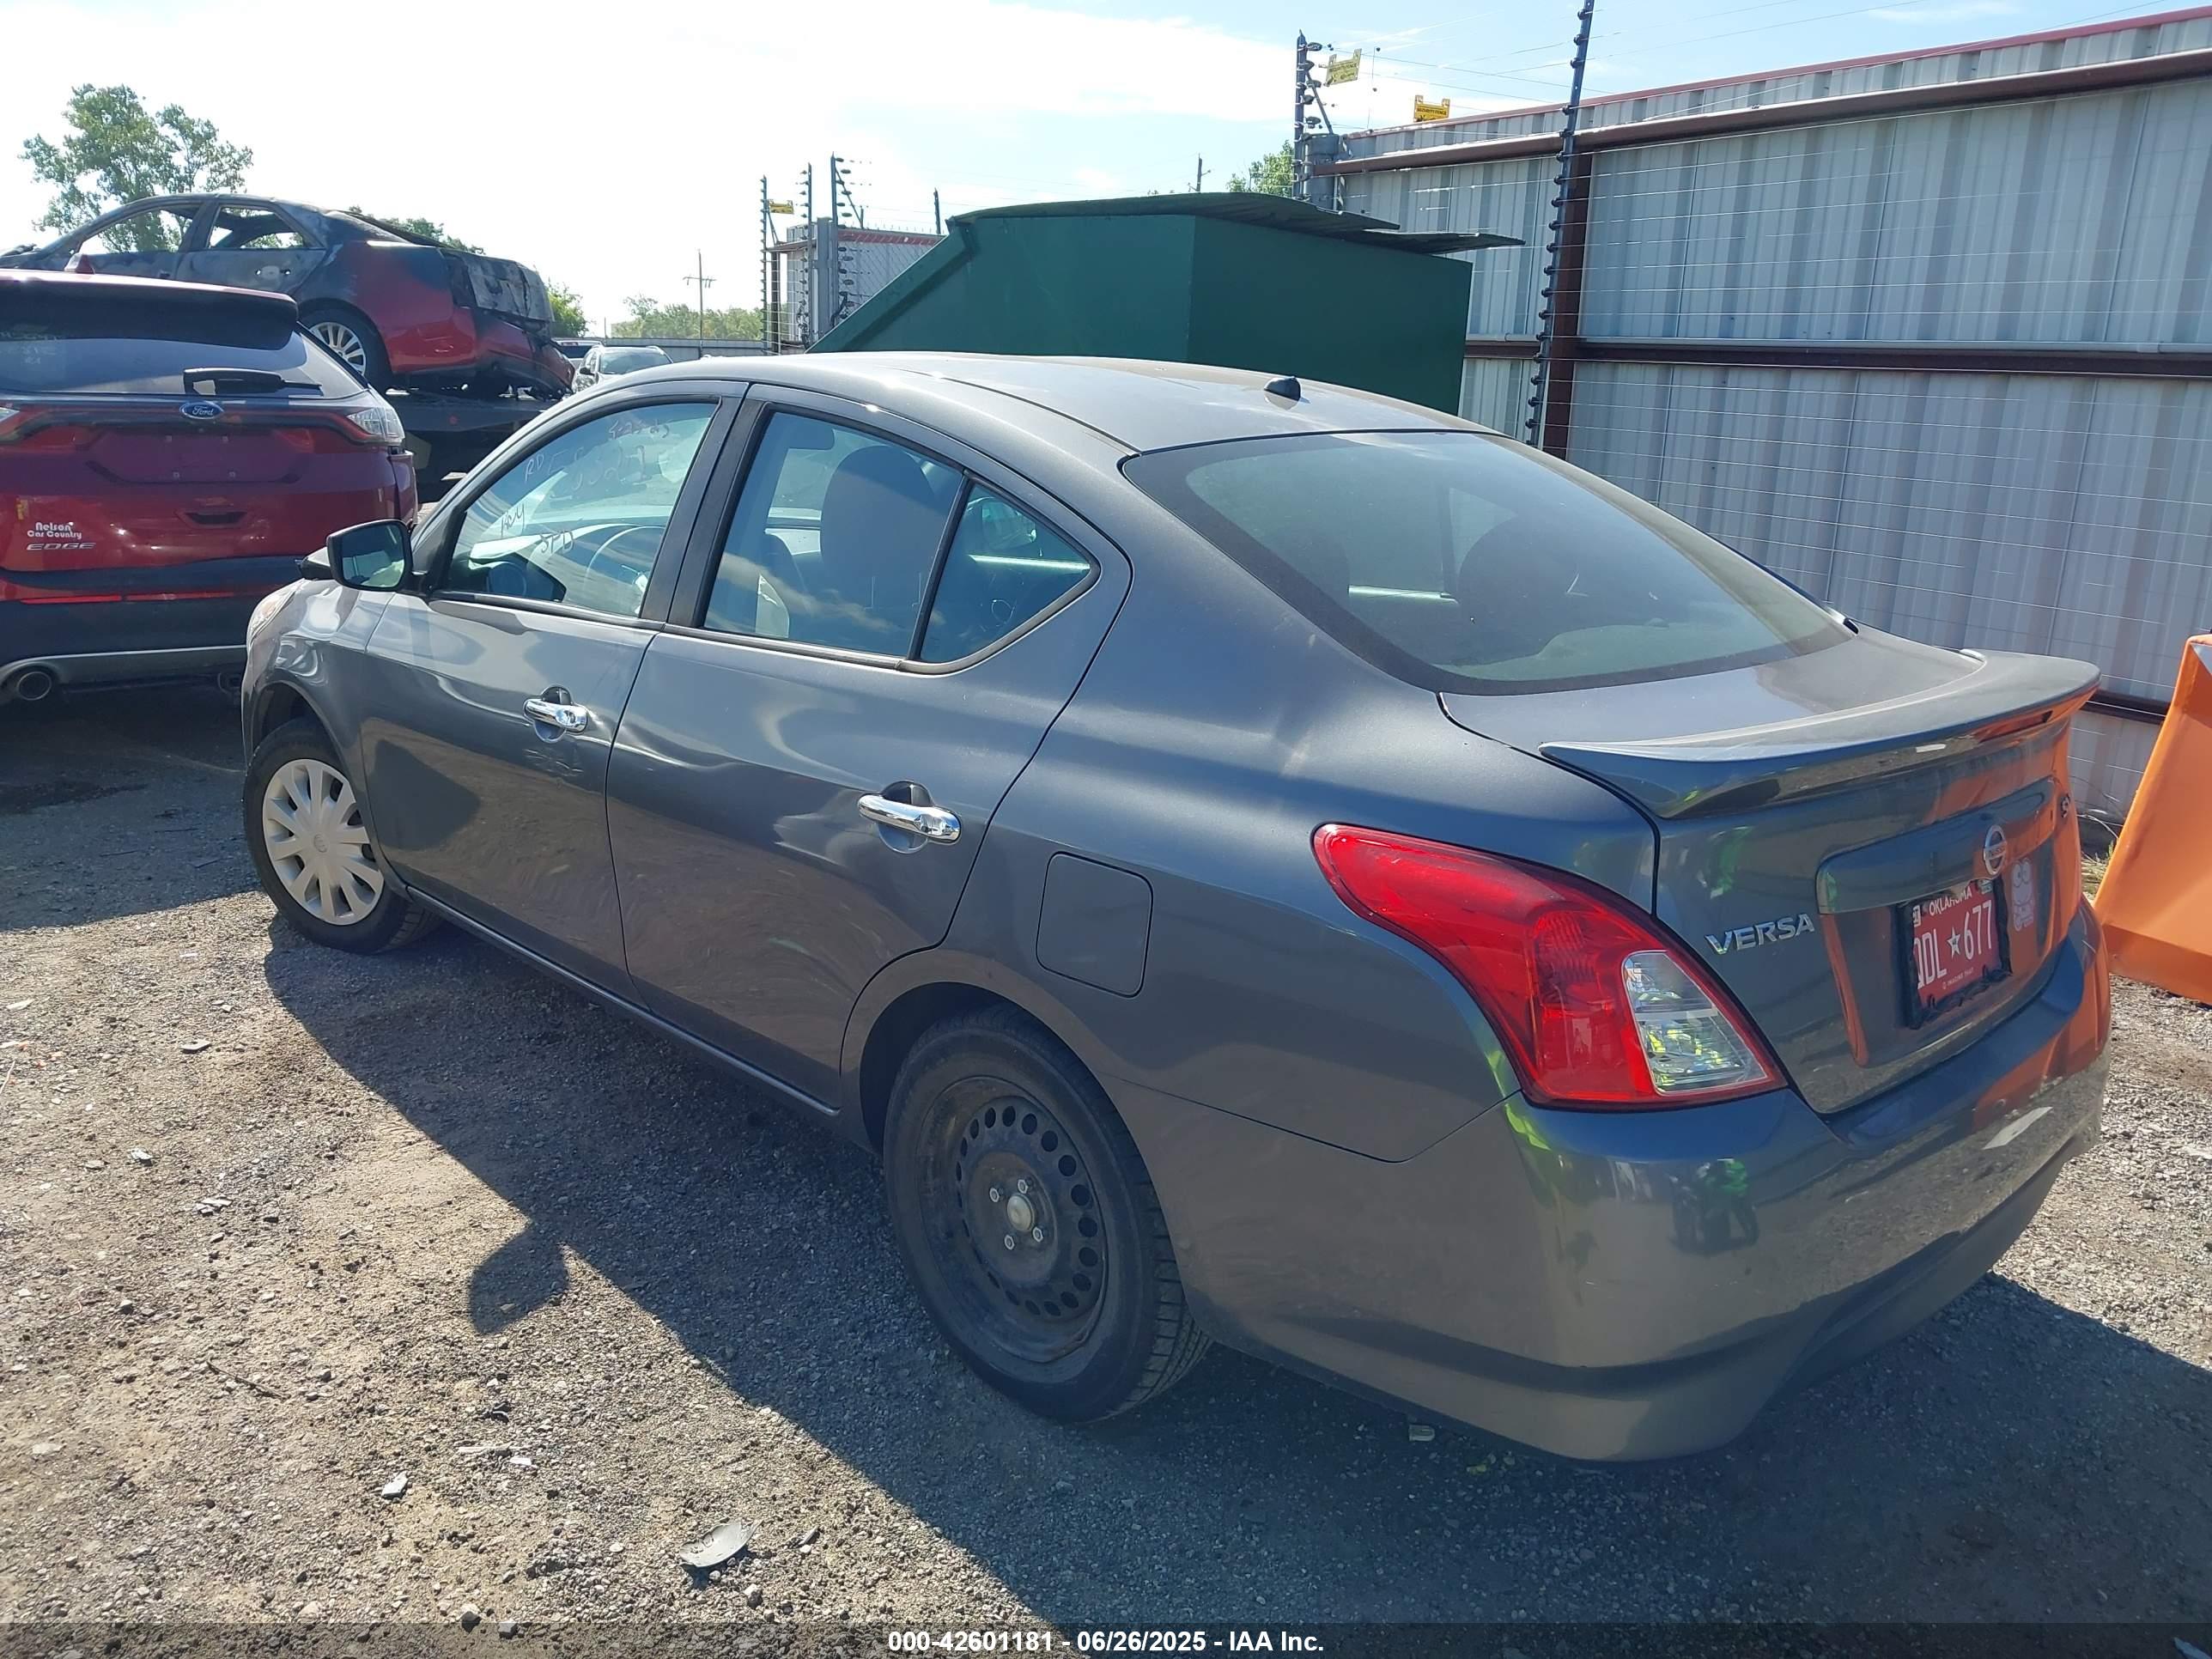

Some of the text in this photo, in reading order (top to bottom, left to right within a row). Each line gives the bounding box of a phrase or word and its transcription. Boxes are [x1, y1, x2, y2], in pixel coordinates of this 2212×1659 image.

[191, 405, 214, 416] Ford
[35, 521, 71, 531] Nelson
[46, 530, 82, 540] Country
[1704, 913, 1815, 955] VERSA
[1964, 900, 1992, 960] 677
